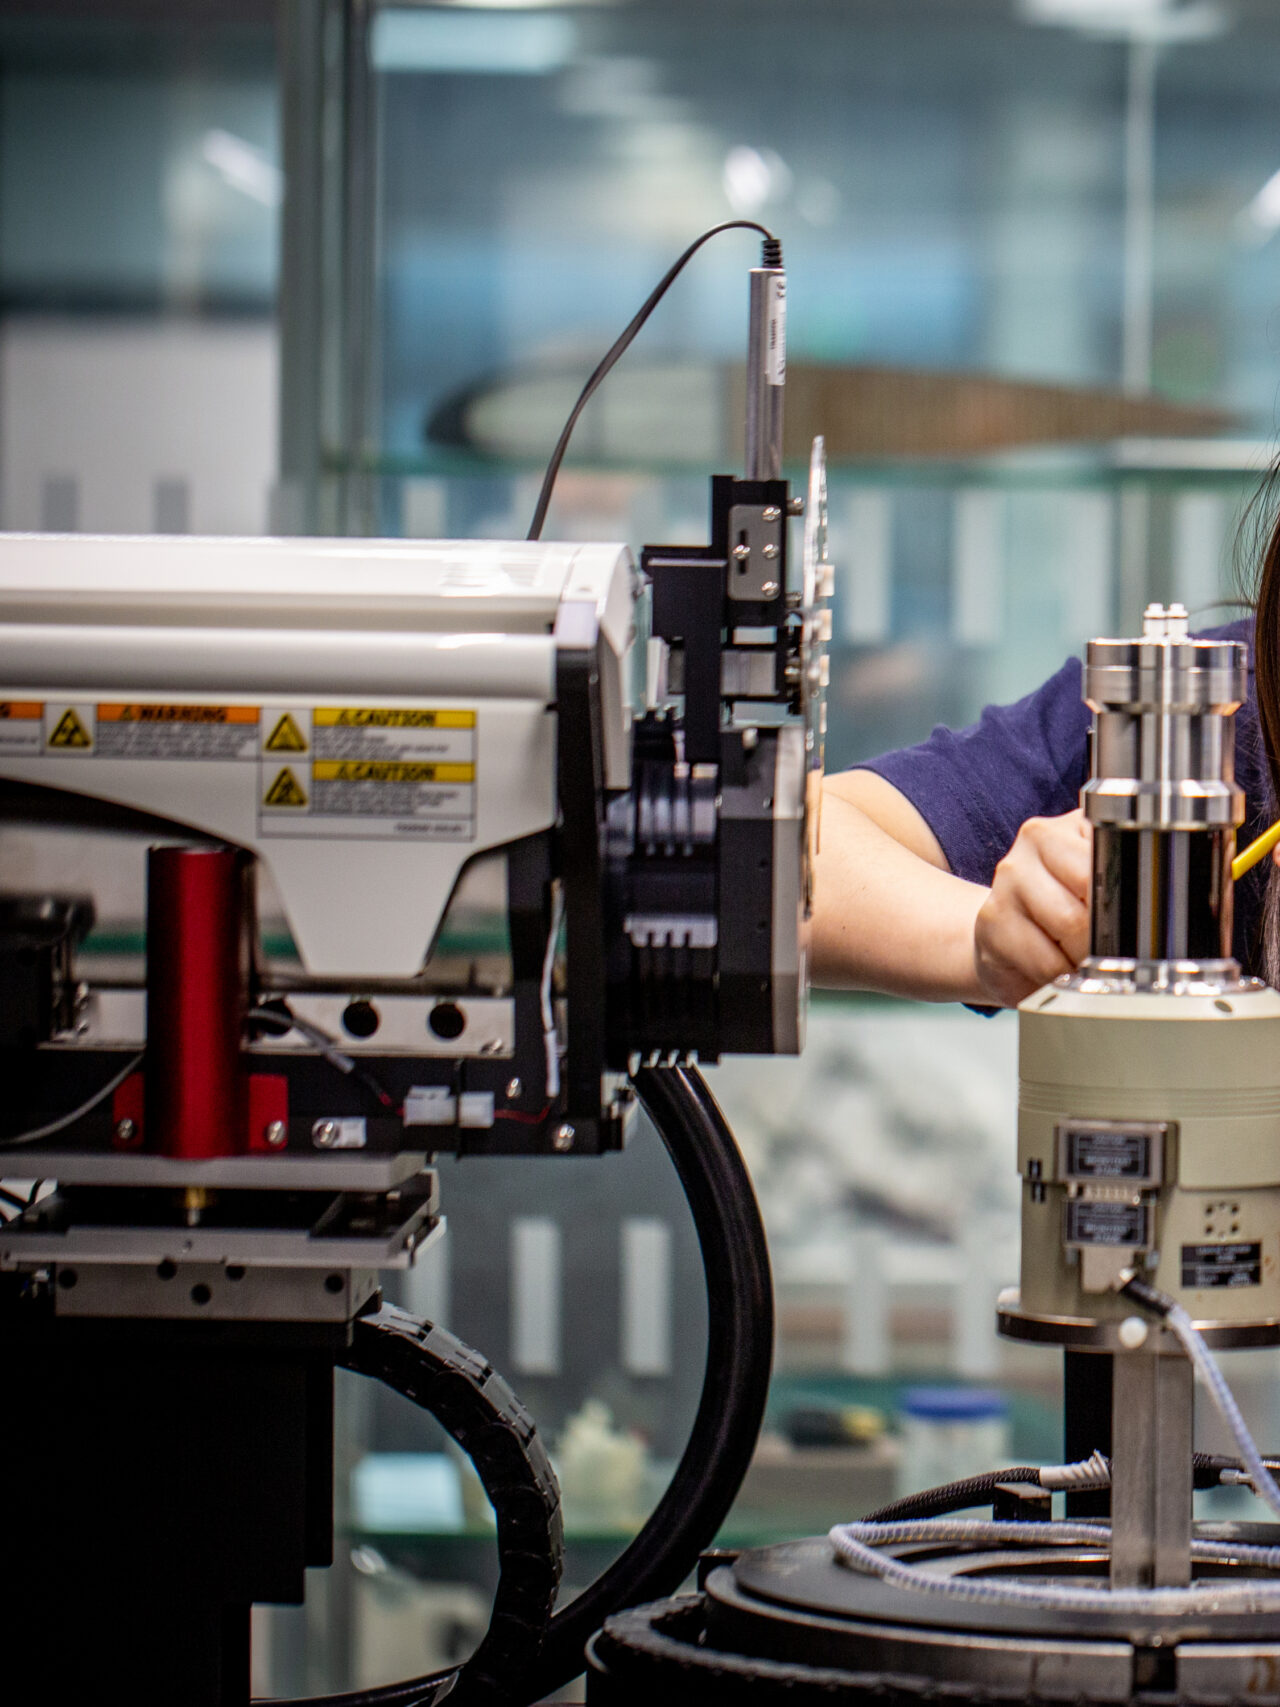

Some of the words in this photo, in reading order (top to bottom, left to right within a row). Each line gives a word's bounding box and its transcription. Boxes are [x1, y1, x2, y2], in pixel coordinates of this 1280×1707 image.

[139, 706, 227, 722] WARNING
[350, 710, 437, 727] CAUTION
[350, 763, 436, 780] CAUTION
